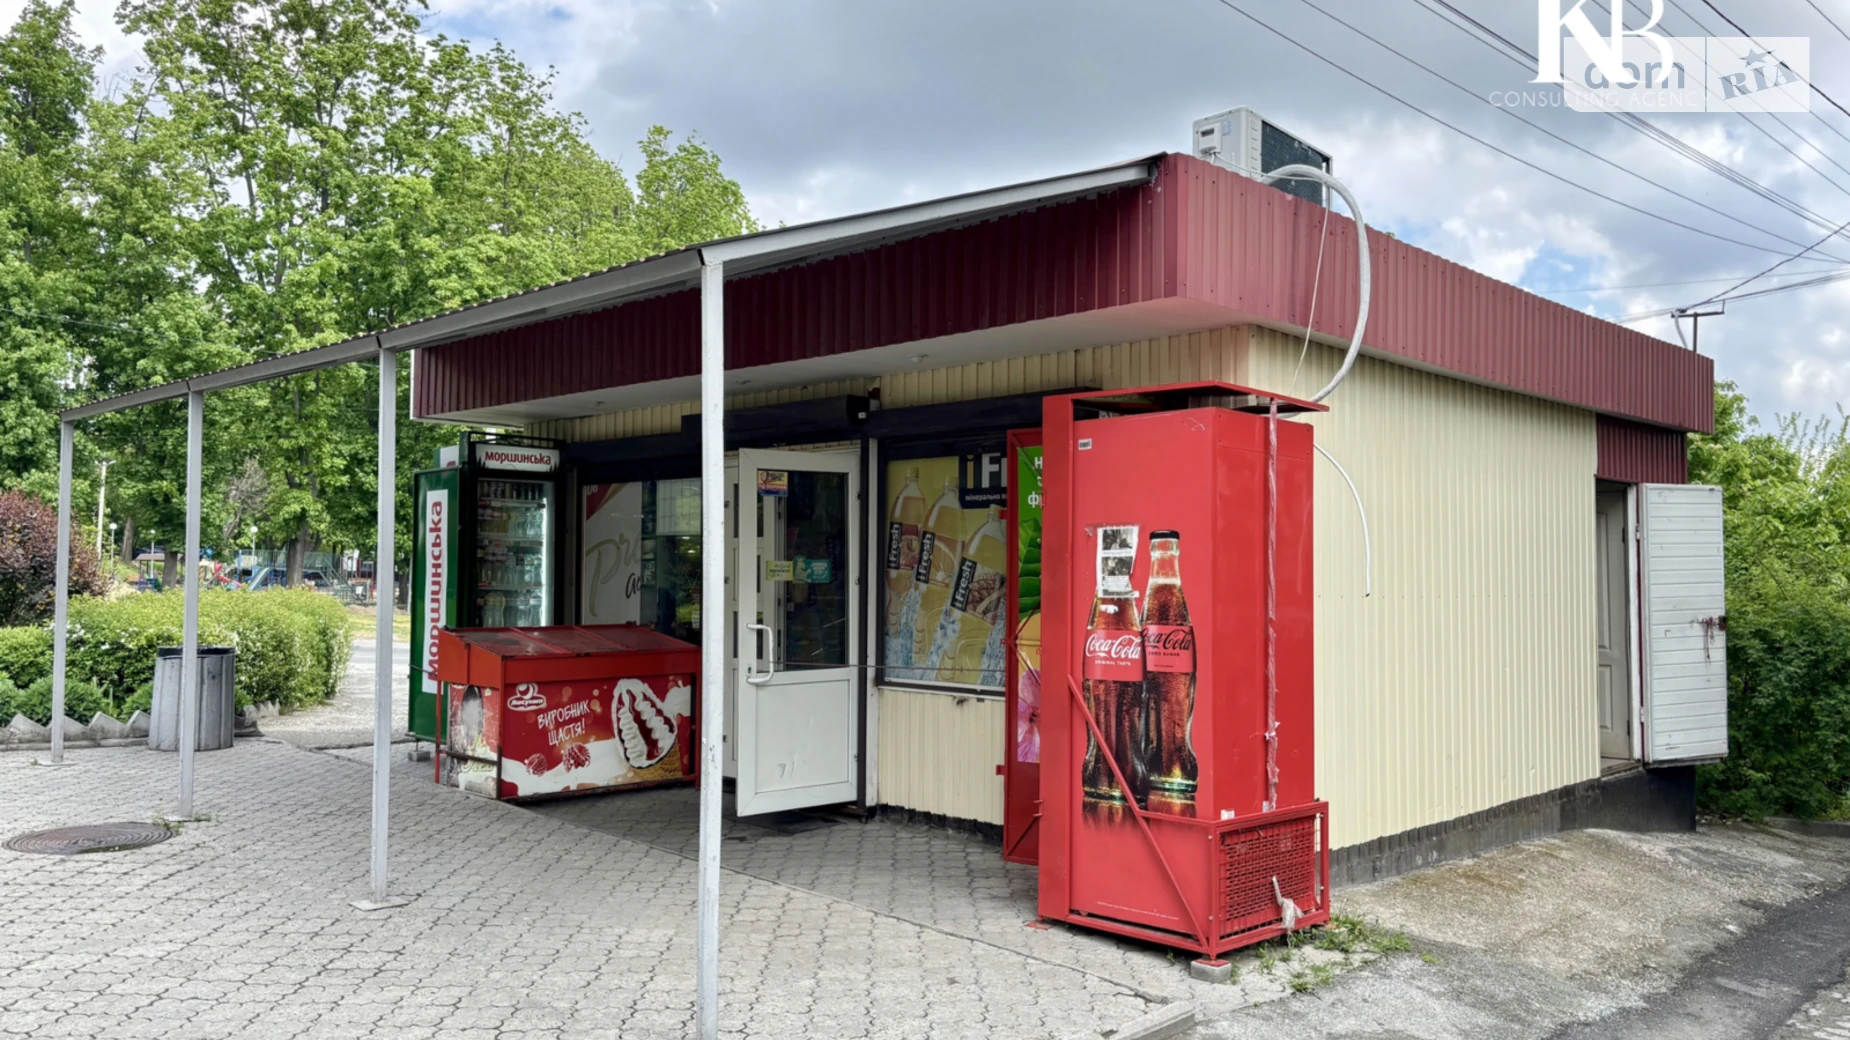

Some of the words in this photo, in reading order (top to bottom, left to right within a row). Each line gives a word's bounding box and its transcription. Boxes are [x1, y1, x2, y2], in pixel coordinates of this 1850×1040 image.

[1027, 491, 1043, 509] ф
[1085, 633, 1142, 660] Coca-Cola
[537, 700, 591, 730] ВИРОБНИК
[548, 718, 586, 746] ЩАСТЯ!
